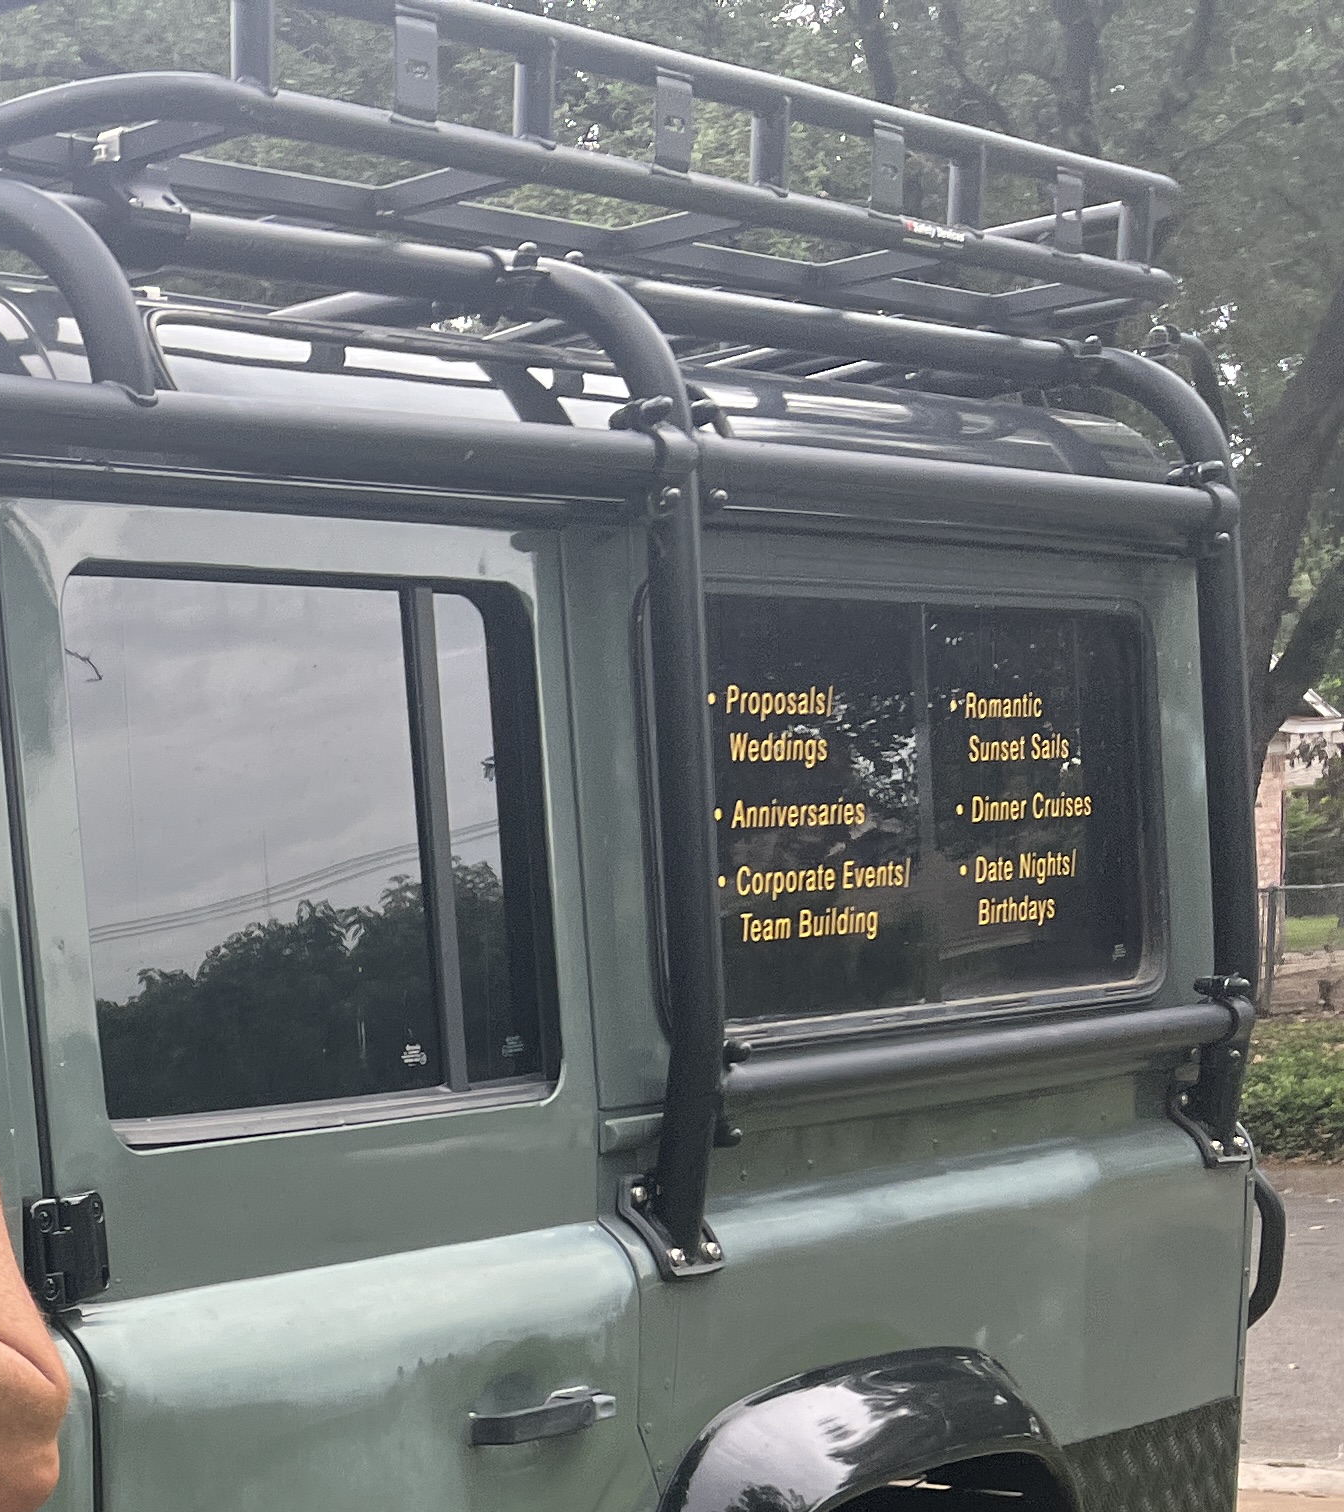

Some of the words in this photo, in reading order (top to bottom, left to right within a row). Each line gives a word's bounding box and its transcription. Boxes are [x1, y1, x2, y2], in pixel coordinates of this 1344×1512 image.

[725, 685, 834, 721] Proposals/
[964, 691, 1043, 719] Romantic
[729, 732, 828, 768] Weddings
[968, 735, 1026, 763] Sunset
[1031, 732, 1070, 761] Sails
[730, 797, 866, 829] Anniversaries
[970, 796, 1027, 823] Dinner
[1032, 791, 1092, 819] Cruises
[735, 864, 835, 900] Corporate
[842, 858, 911, 891] Events/
[974, 855, 1013, 884] Date
[1019, 848, 1077, 880] Nights/
[740, 912, 791, 943] Team
[798, 906, 879, 940] Building
[977, 895, 1056, 926] Birthdays
